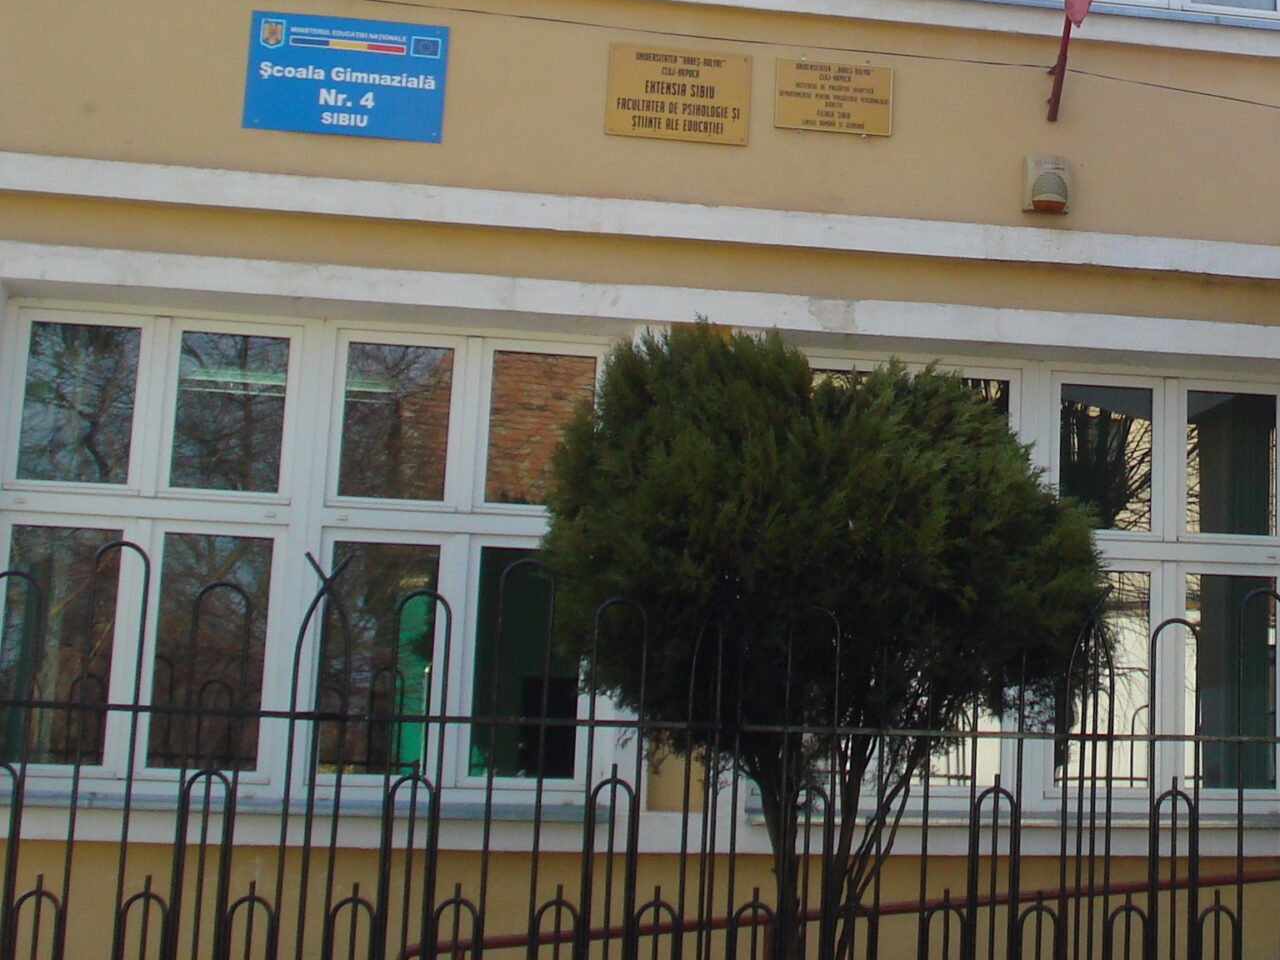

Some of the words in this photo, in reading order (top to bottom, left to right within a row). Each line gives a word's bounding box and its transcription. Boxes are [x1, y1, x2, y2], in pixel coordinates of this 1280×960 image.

[330, 67, 436, 90] Gimnazială
[318, 88, 352, 107] Nr.
[359, 92, 375, 109] 4
[645, 80, 687, 97] EXTENSIA
[690, 84, 716, 99] SIBIU
[616, 97, 665, 114] FACULTATEA
[668, 102, 678, 115] DE
[682, 103, 729, 119] PSIHOLOGIE
[321, 112, 369, 128] SIBIU
[665, 118, 680, 131] ALE
